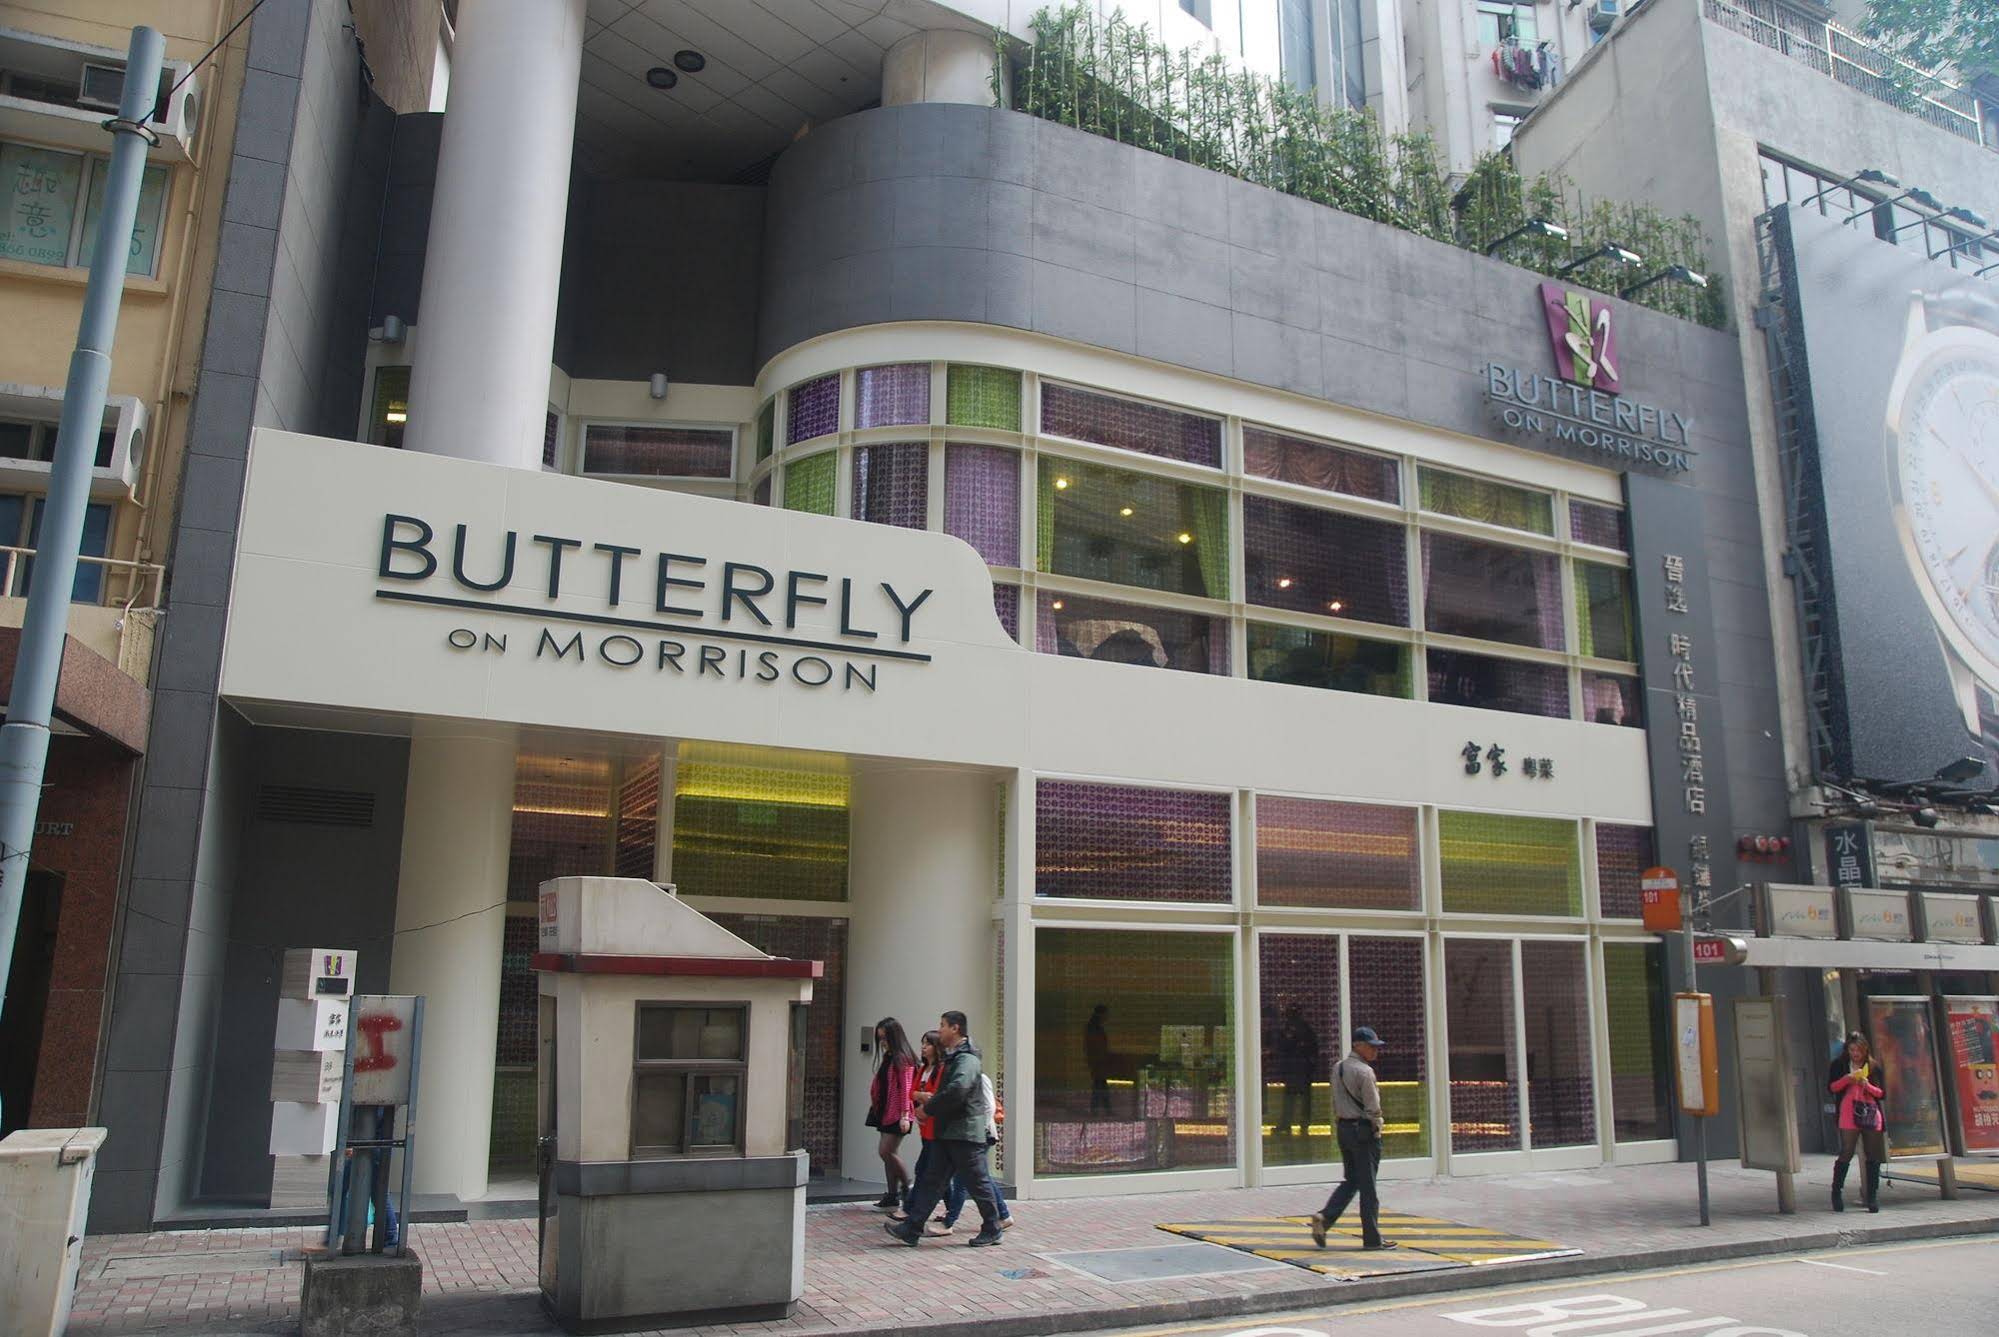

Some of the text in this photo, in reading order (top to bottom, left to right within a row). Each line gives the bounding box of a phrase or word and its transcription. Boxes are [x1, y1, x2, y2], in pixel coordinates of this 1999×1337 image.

[1487, 362, 1694, 446] BUTTERFLY
[1503, 408, 1690, 471] ON MORRISON
[378, 512, 933, 643] BUTTERFLY
[448, 627, 878, 692] ON MORRISON
[36, 821, 74, 836] URT
[1834, 829, 1863, 888] 水晶
[1642, 890, 1660, 904] 101
[1694, 942, 1719, 957] 101
